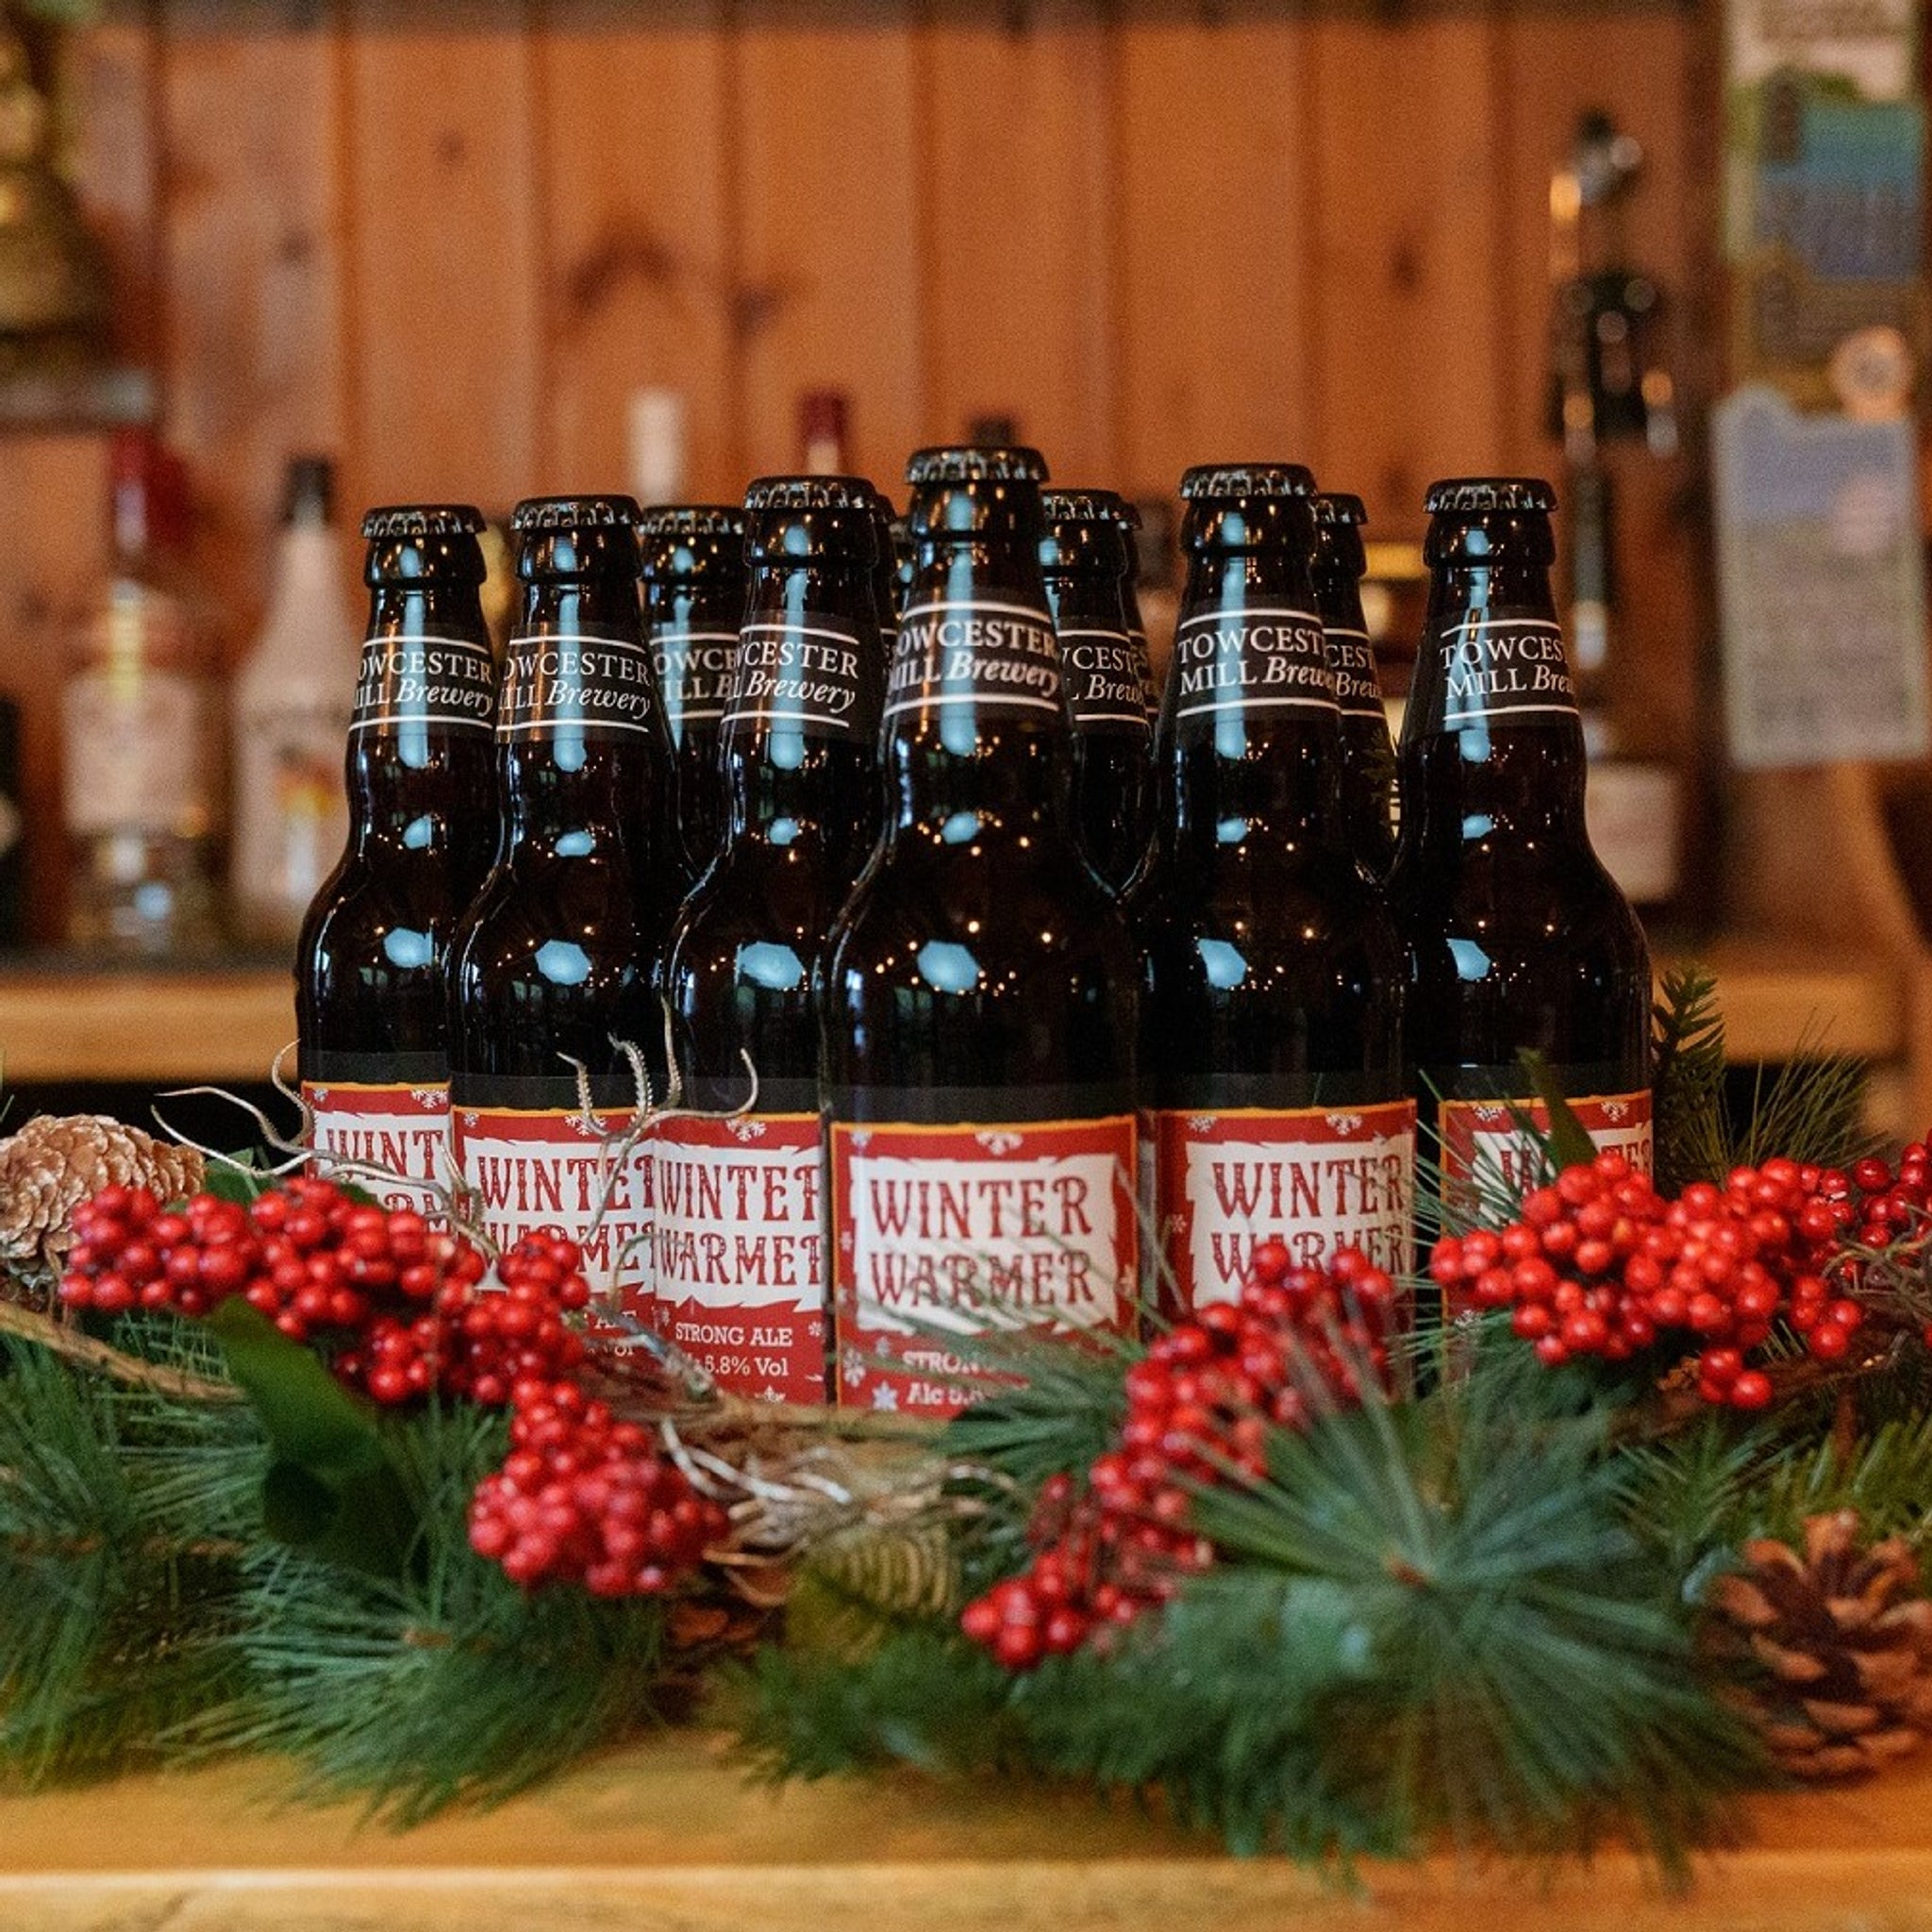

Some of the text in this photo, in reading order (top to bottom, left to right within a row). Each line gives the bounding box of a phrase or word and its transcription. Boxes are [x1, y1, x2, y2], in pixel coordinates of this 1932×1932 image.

[896, 621, 1060, 659] OWCESTER
[1178, 626, 1324, 664] TOWCEST
[1440, 636, 1564, 670] TOWCES
[358, 651, 492, 685] OWCESTER
[504, 652, 650, 687] OWCESTER
[742, 641, 858, 679] CESTER
[944, 651, 1058, 698] Brewery
[1180, 659, 1257, 696] MILL
[355, 677, 493, 717] ILL Brewery
[499, 679, 650, 720] ILL Brewery
[665, 676, 710, 701] ILL
[744, 671, 856, 714] Brewery
[1445, 668, 1527, 699] MILL
[326, 1128, 443, 1180] WINT
[1211, 1154, 1404, 1219] WINTER
[870, 1177, 1092, 1240] WINTER
[871, 1251, 1094, 1308] WARMER
[675, 1323, 793, 1347] STRONG ALE
[755, 1357, 790, 1377] Vol
